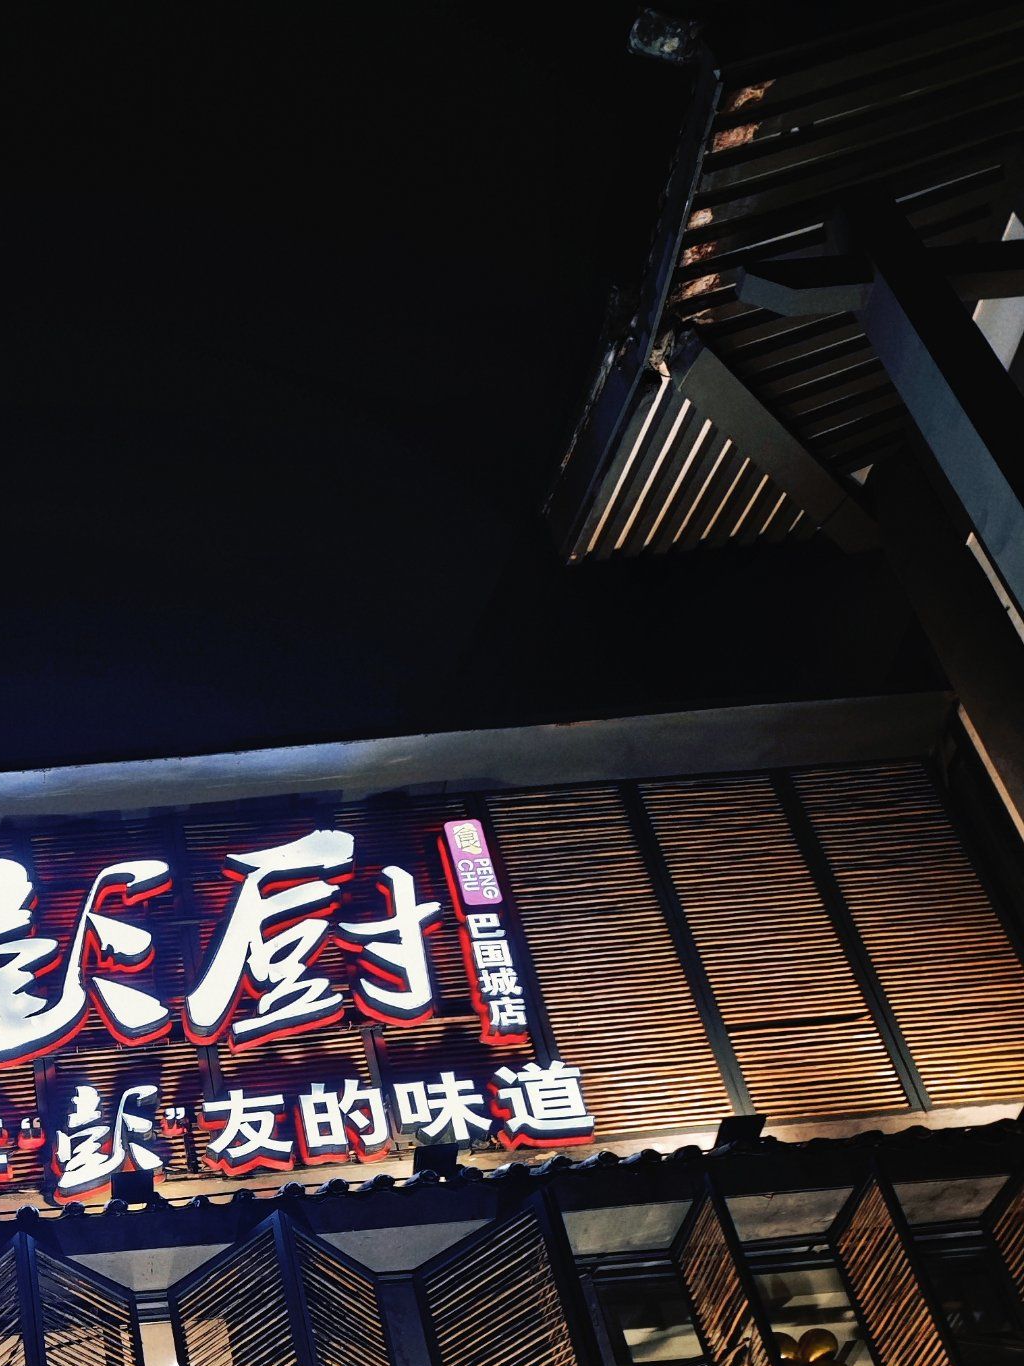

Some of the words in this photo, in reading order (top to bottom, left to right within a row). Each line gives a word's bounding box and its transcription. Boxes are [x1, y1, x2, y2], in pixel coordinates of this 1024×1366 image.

[457, 859, 480, 892] CHU
[473, 857, 499, 900] PENG
[466, 913, 527, 1026] 巴国城店
